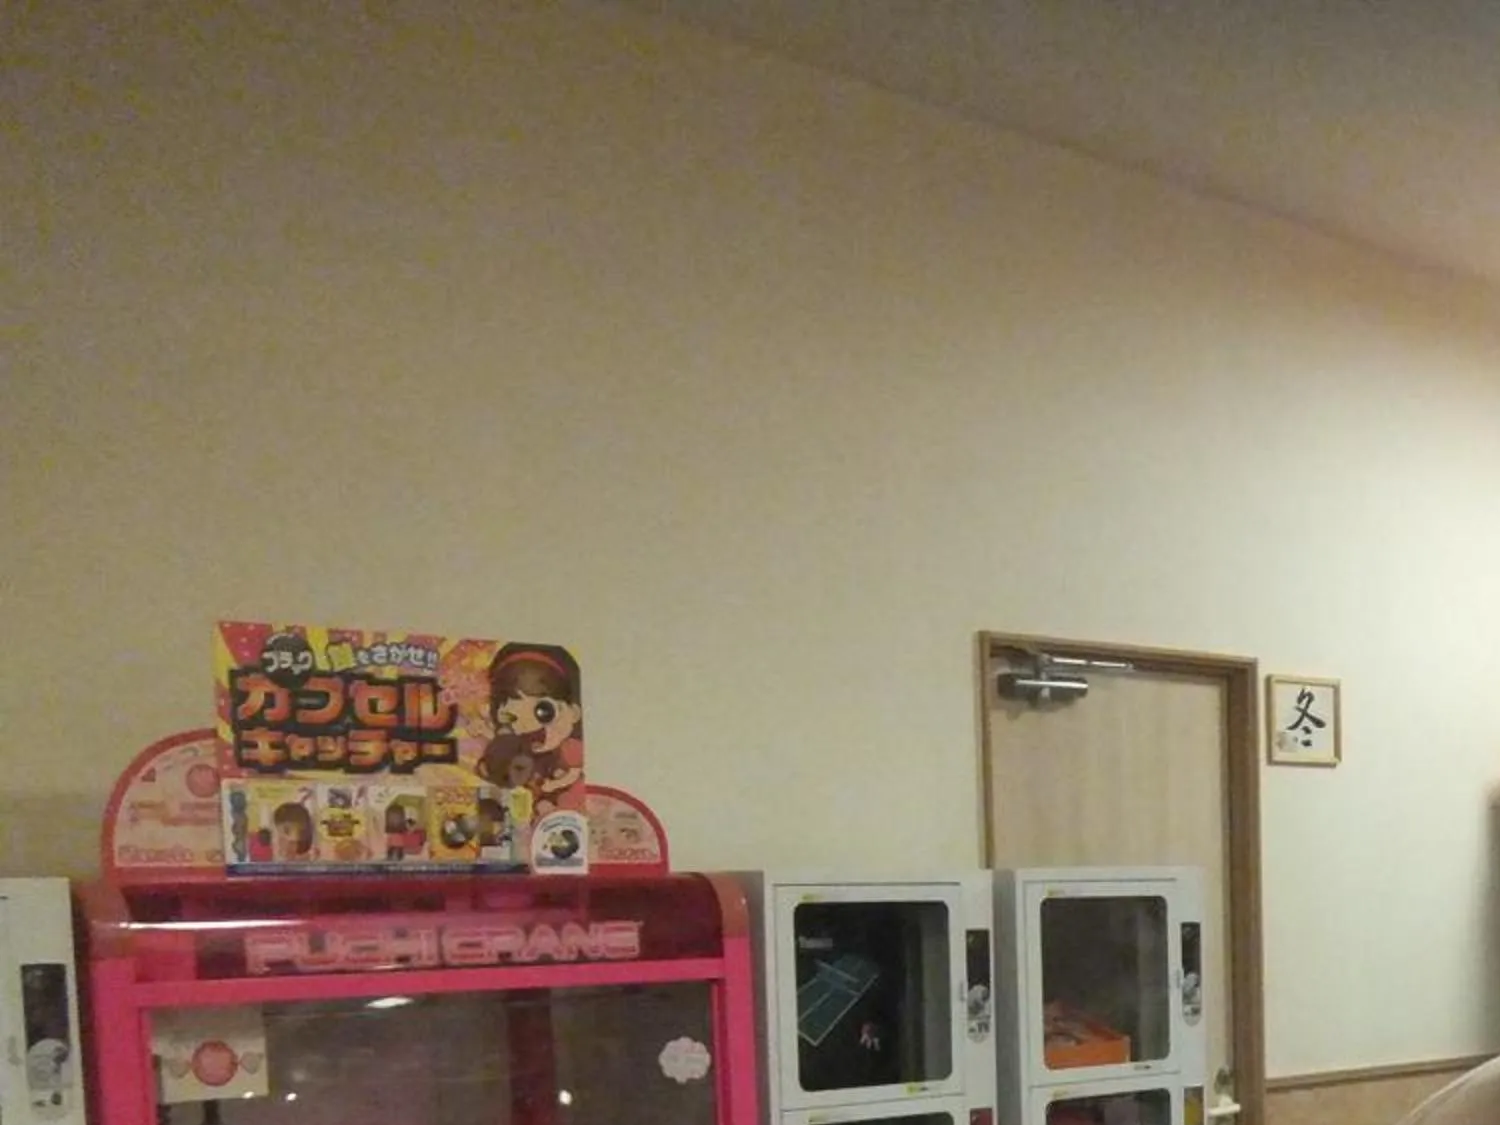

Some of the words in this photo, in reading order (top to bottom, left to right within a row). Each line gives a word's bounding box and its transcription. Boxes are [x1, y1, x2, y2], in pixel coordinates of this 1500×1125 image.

[1284, 688, 1326, 747] 冬
[238, 727, 455, 768] キャッチャー
